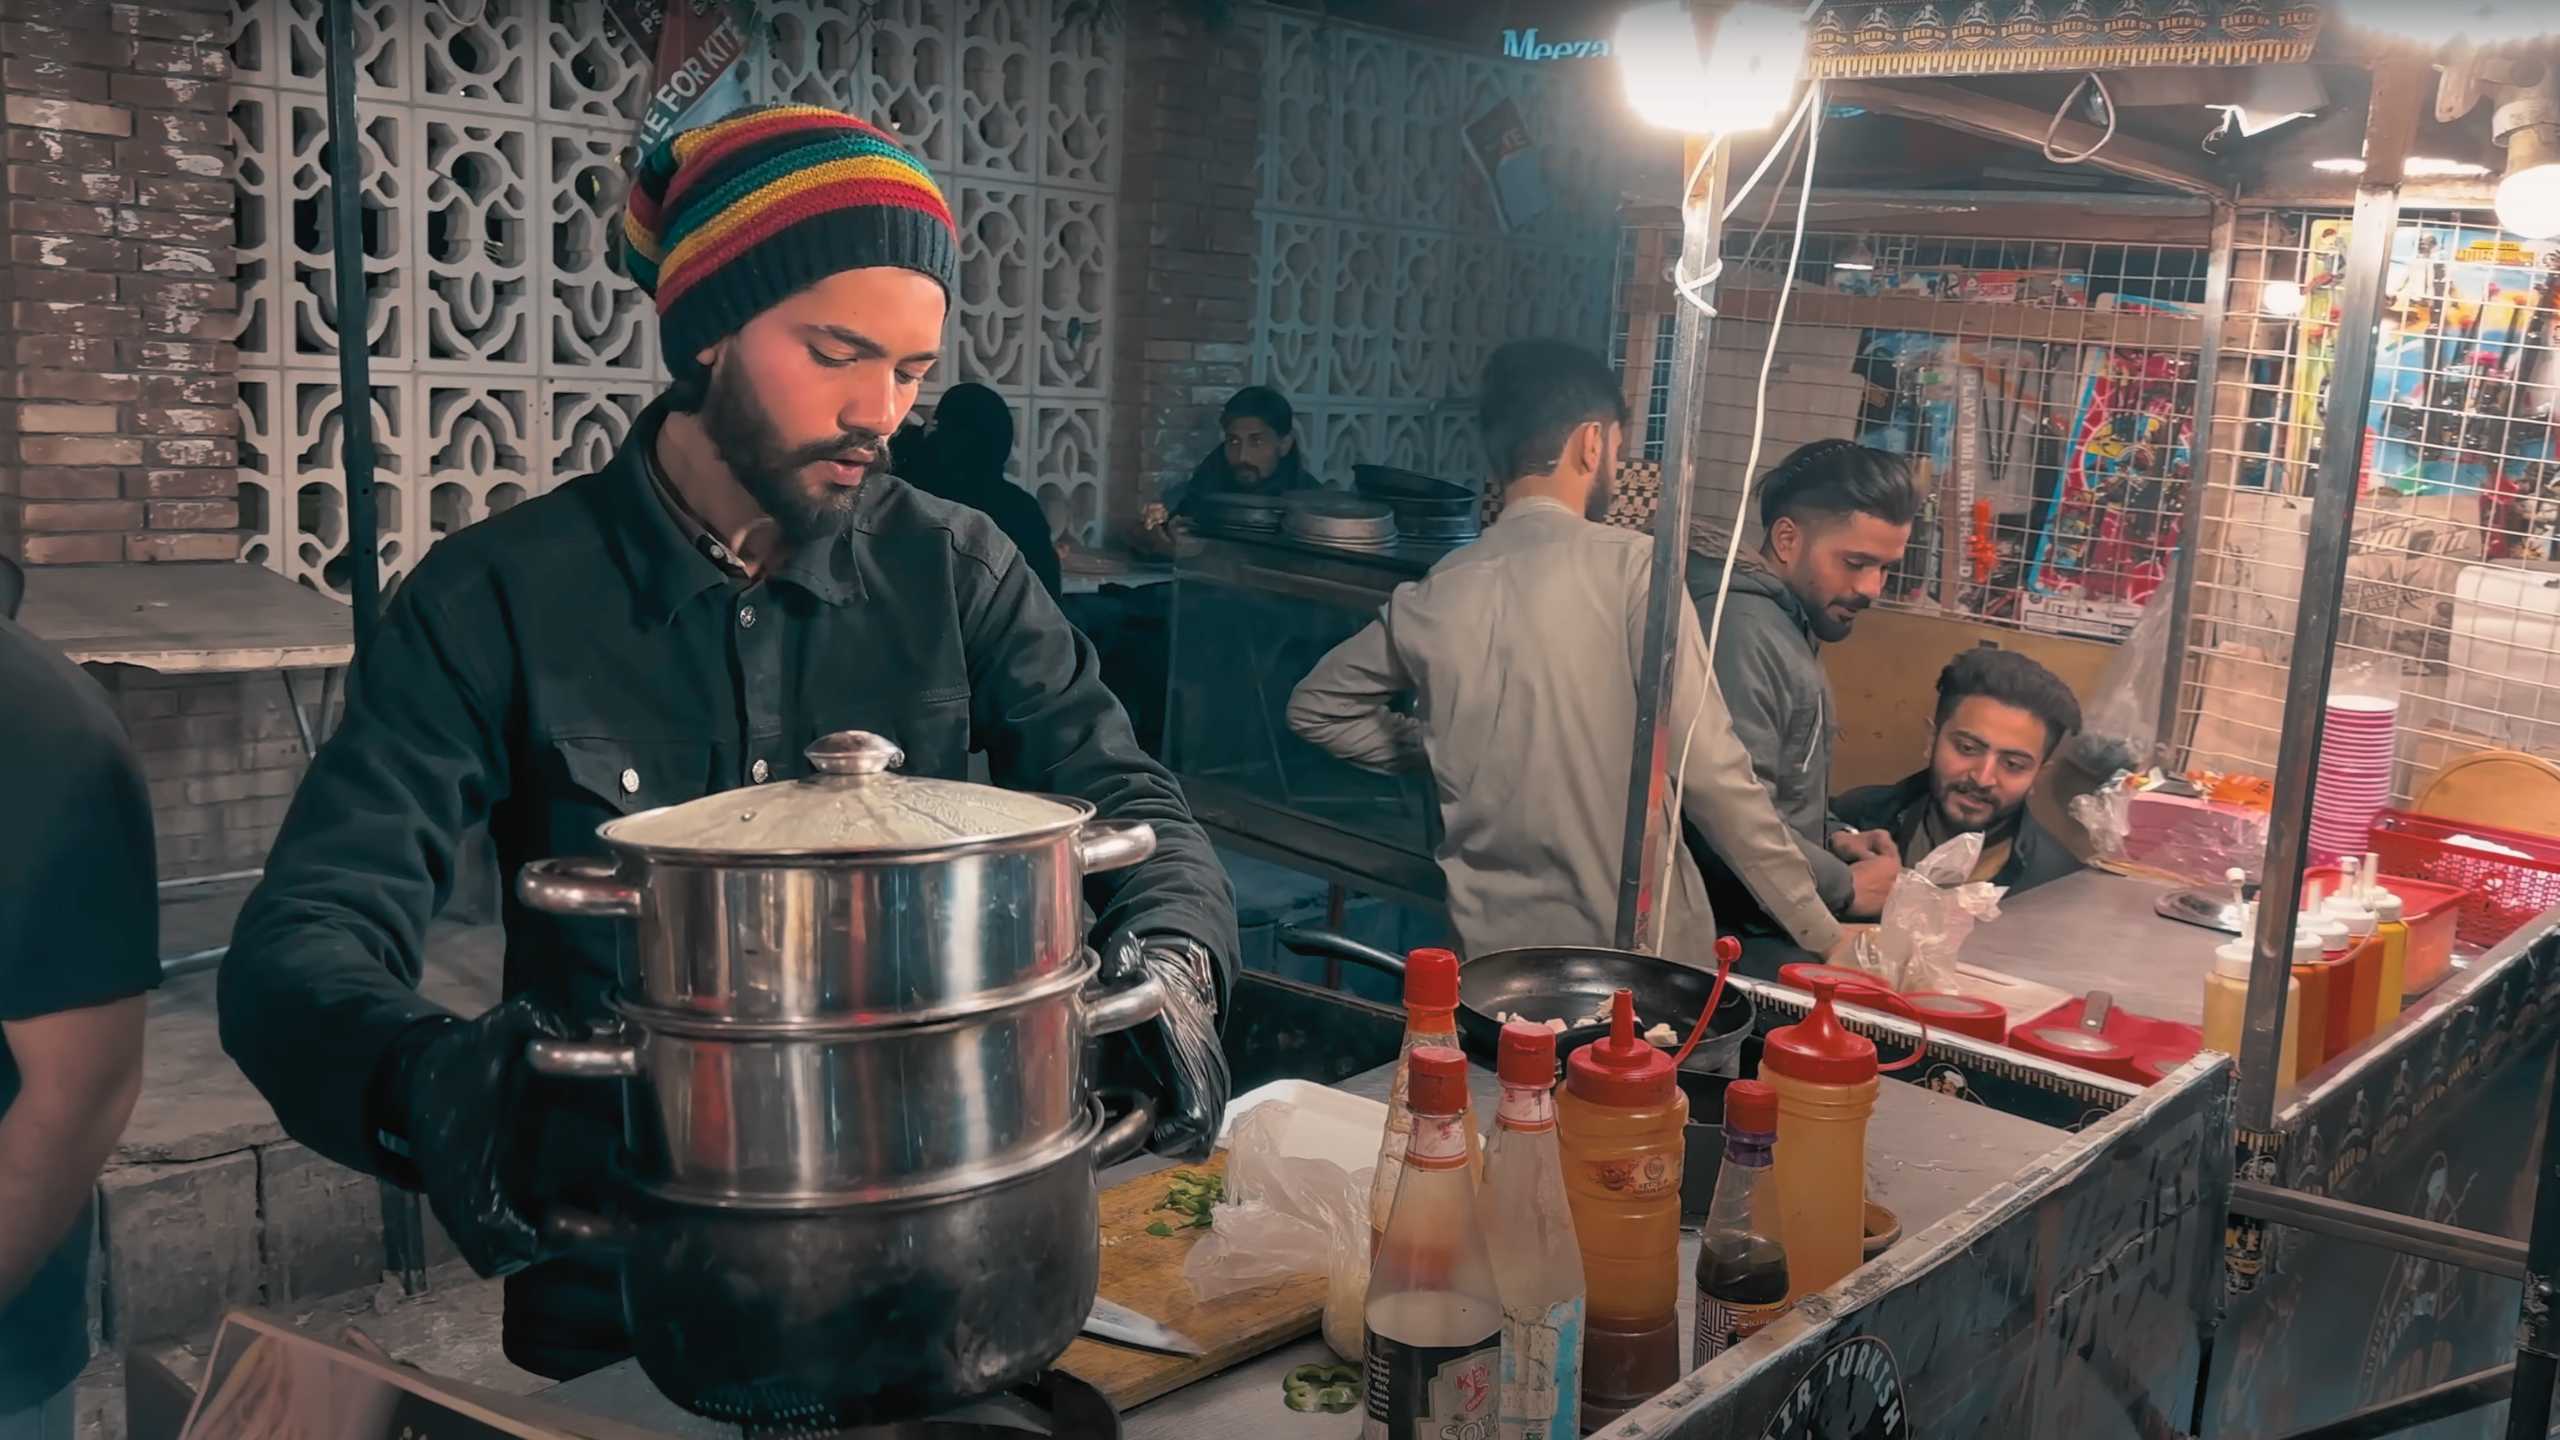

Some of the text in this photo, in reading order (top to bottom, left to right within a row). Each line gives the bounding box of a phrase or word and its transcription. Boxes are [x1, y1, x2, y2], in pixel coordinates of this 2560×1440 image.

[656, 57, 711, 111] FOR
[1961, 373, 1977, 417] PLAY
[1959, 515, 1974, 578] FRD
[1826, 1344, 1901, 1436] TURKISH
